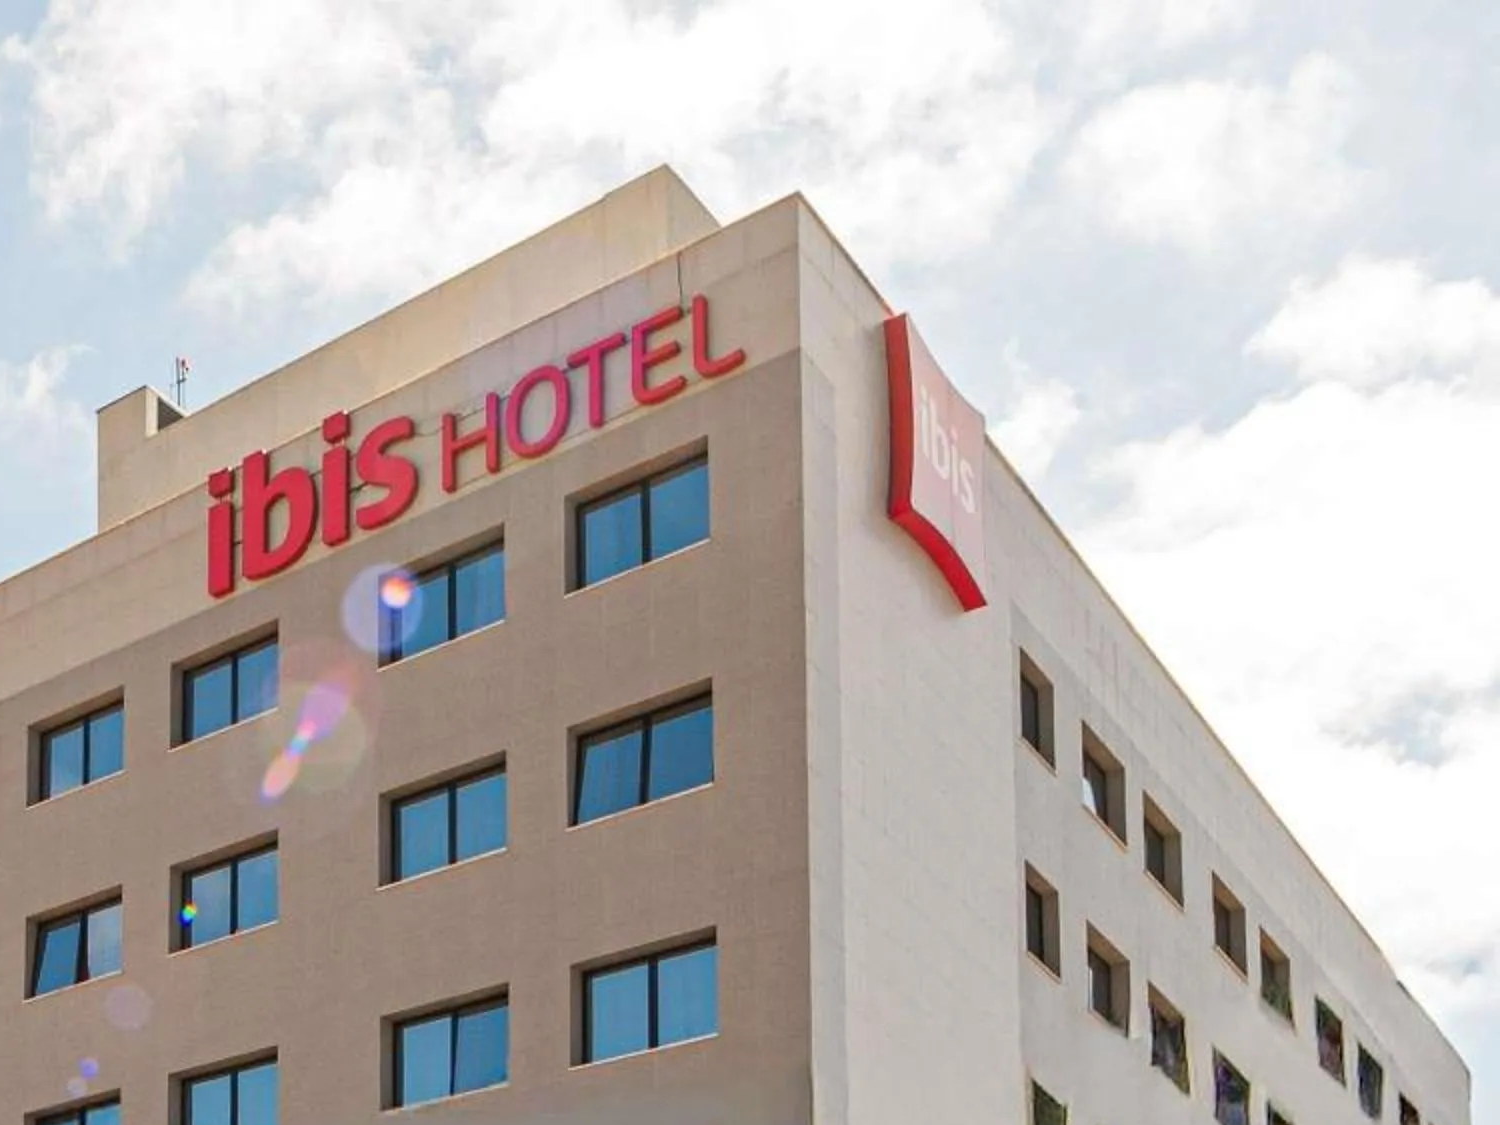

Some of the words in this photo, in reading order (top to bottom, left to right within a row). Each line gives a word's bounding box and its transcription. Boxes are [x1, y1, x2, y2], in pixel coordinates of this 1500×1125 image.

[207, 410, 420, 598] ibis
[441, 295, 746, 494] HOTEL
[919, 383, 976, 515] ibis
